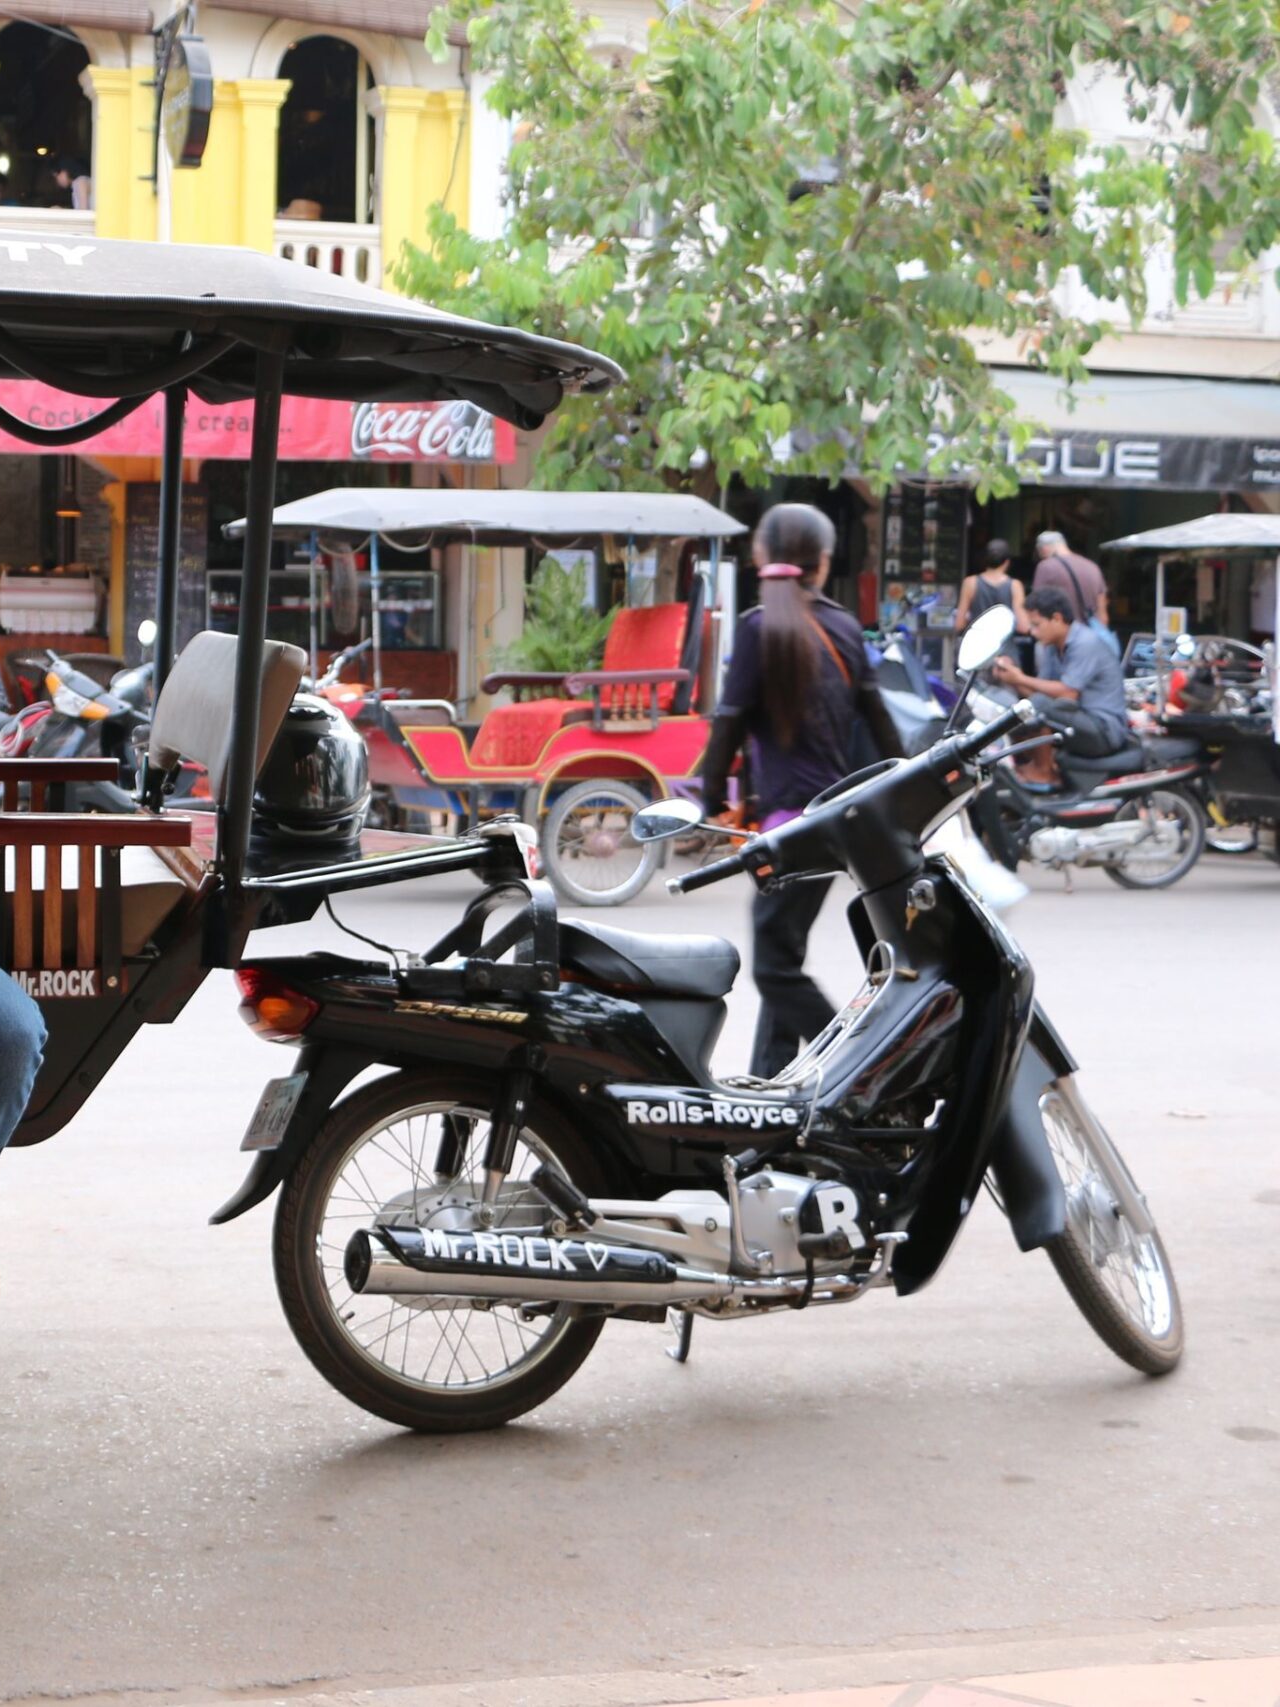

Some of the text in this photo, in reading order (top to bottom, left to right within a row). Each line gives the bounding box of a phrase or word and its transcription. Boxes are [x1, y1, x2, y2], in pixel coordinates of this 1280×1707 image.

[351, 401, 494, 458] Coca-Cola
[627, 1101, 798, 1129] Rolls-Royce
[816, 1186, 866, 1250] R
[420, 1228, 577, 1271] Mr.ROCK
